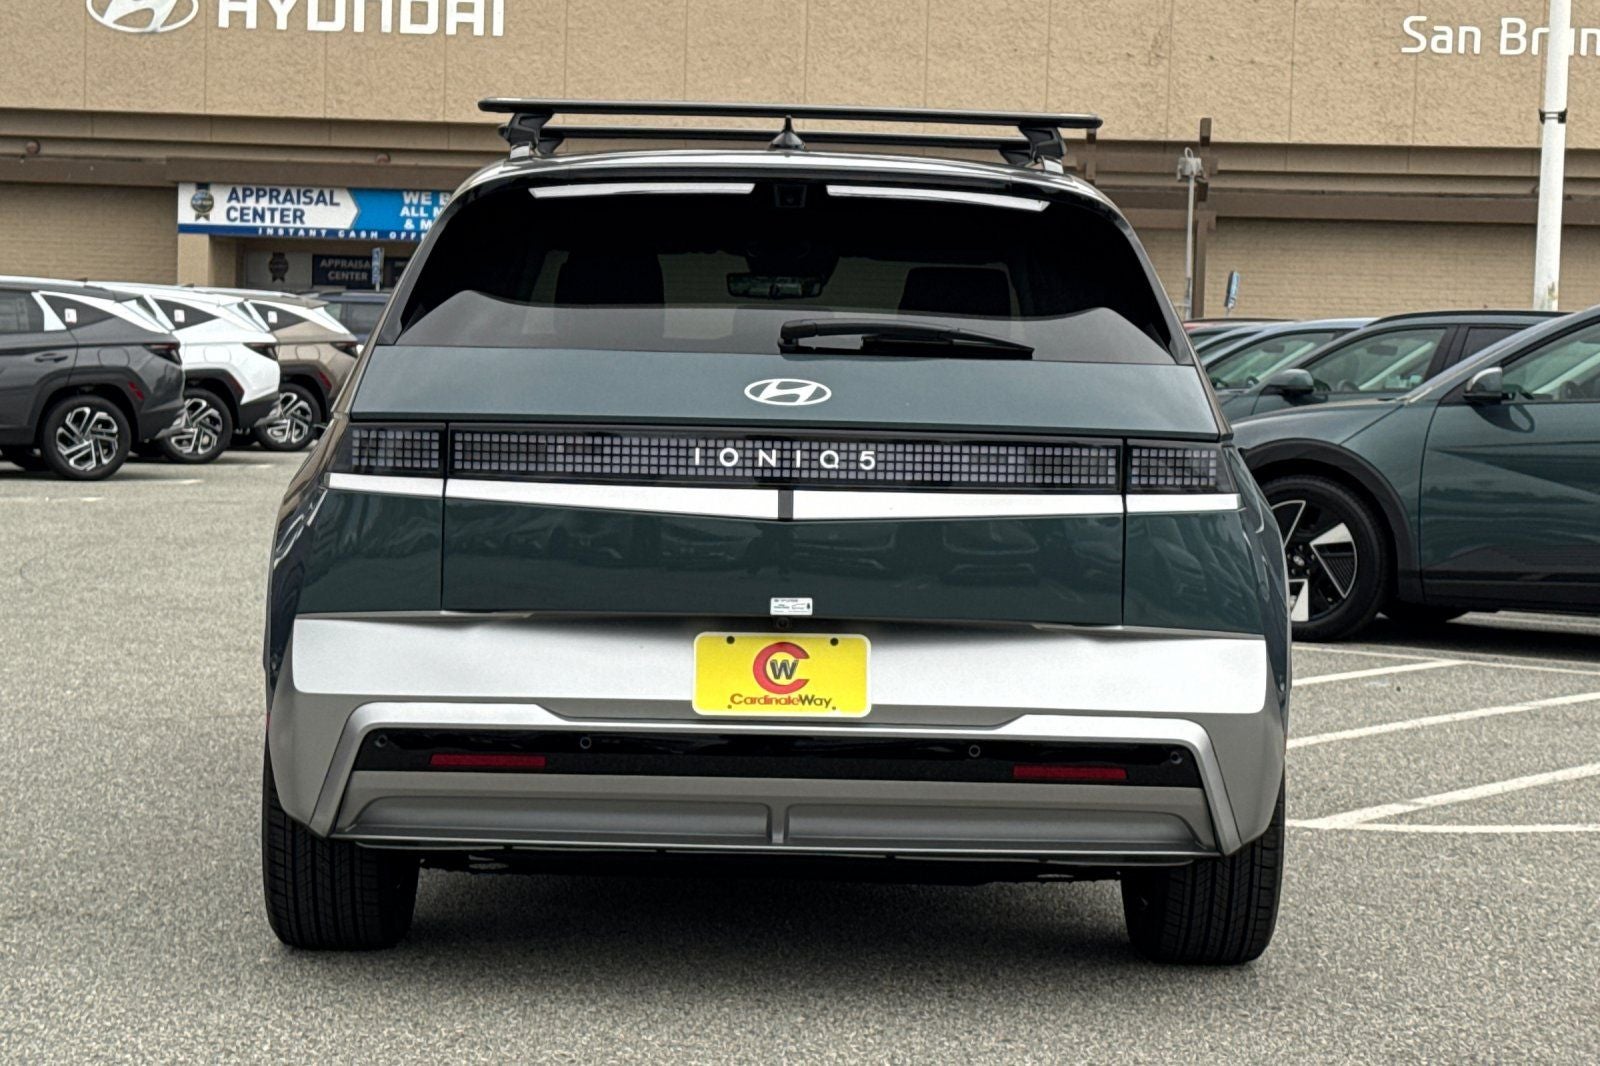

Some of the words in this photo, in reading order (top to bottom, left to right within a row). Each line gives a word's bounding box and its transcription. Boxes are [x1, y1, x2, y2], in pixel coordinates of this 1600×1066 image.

[218, 0, 505, 37] HYUNDAI
[1401, 16, 1481, 54] San
[1500, 17, 1600, 56] Brn
[226, 187, 341, 206] APPRAISAL
[402, 191, 433, 205] WE
[226, 206, 305, 224] CENTER
[400, 206, 429, 217] ALL
[404, 218, 415, 230] &
[258, 227, 327, 238] INSTANT
[338, 230, 378, 239] CASH
[320, 258, 370, 269] APPRAISA
[327, 271, 369, 281] CENTER
[729, 693, 832, 709] CardinaleWay
